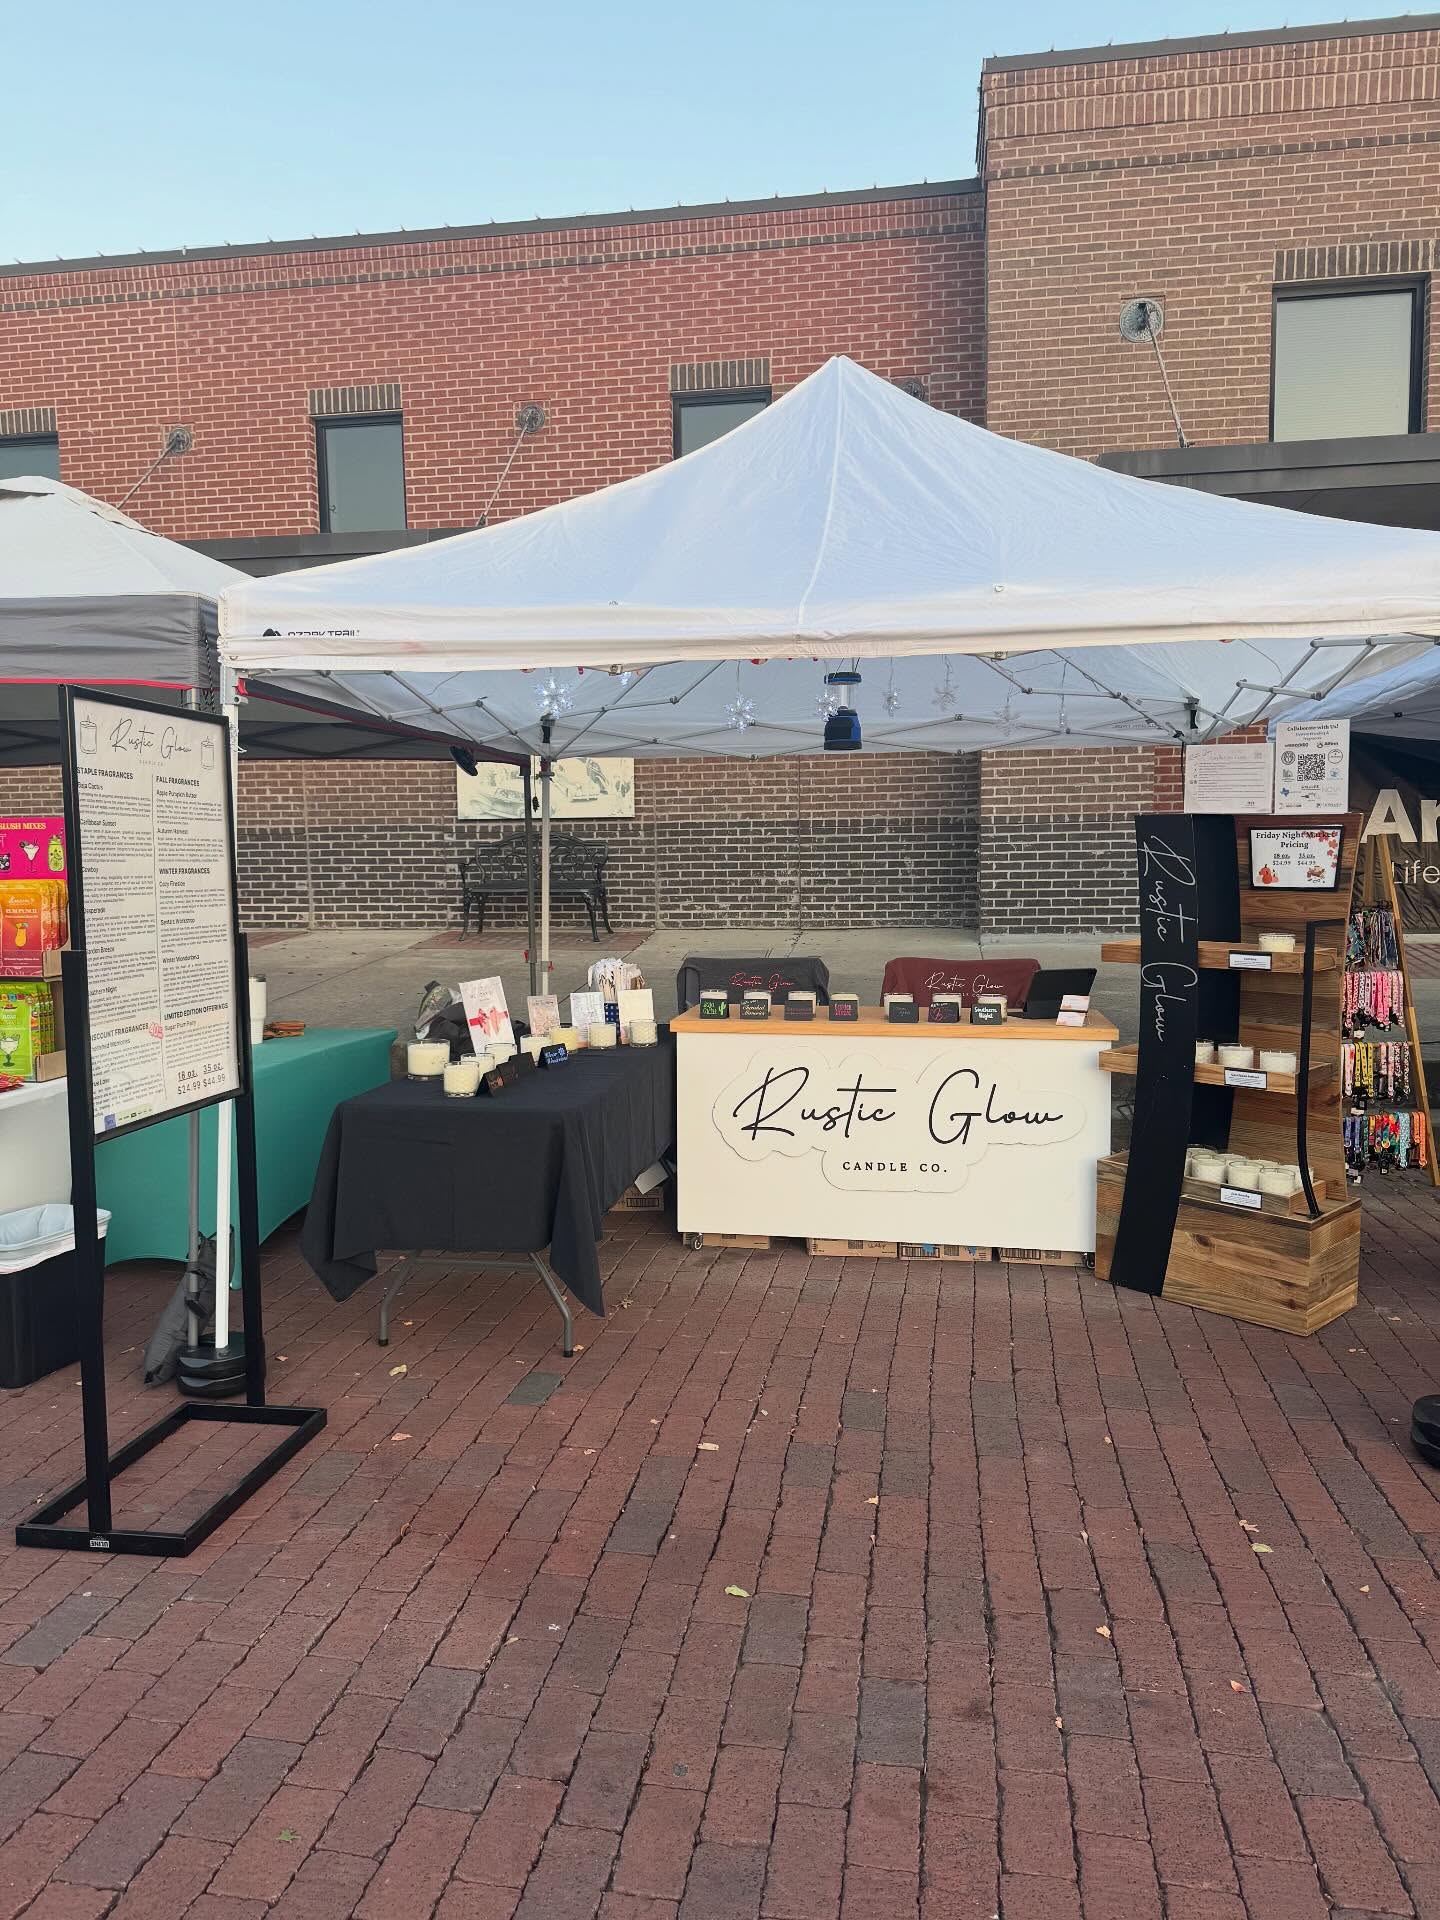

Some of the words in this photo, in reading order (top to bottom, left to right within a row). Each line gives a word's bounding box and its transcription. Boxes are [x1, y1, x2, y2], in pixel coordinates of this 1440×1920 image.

[109, 717, 155, 754] Rustic
[160, 727, 192, 760] Glow
[77, 766, 98, 776] STAPLE
[98, 769, 134, 780] FRAGRANCES
[156, 775, 168, 784] FALL
[168, 777, 200, 787] FRAGRANCES
[1256, 832, 1280, 840] Friday
[1282, 831, 1304, 840] Night
[1305, 831, 1336, 839] Market
[1280, 841, 1309, 849] Pricing
[159, 867, 178, 875] WINTER
[178, 867, 210, 875] FRAGRANCES
[1138, 835, 1196, 944] Rustic
[925, 972, 966, 991] Rustic
[971, 974, 1005, 994] Glow
[1141, 962, 1199, 1042] Glow
[164, 1011, 184, 1021] LIMITED
[183, 1007, 203, 1017] EDITION
[203, 1002, 229, 1013] OFFERINGS
[978, 1012, 994, 1021] Night
[91, 1030, 114, 1042] ISCOUNT
[114, 1022, 149, 1037] FRAGRANCES
[203, 1064, 212, 1073] 35
[177, 1080, 201, 1094] $24.99
[203, 1073, 226, 1087] $44.99
[733, 1066, 897, 1141] Rustic
[928, 1068, 1063, 1145] Glow
[842, 1160, 909, 1172] CANDLE
[919, 1162, 948, 1173] CO.
